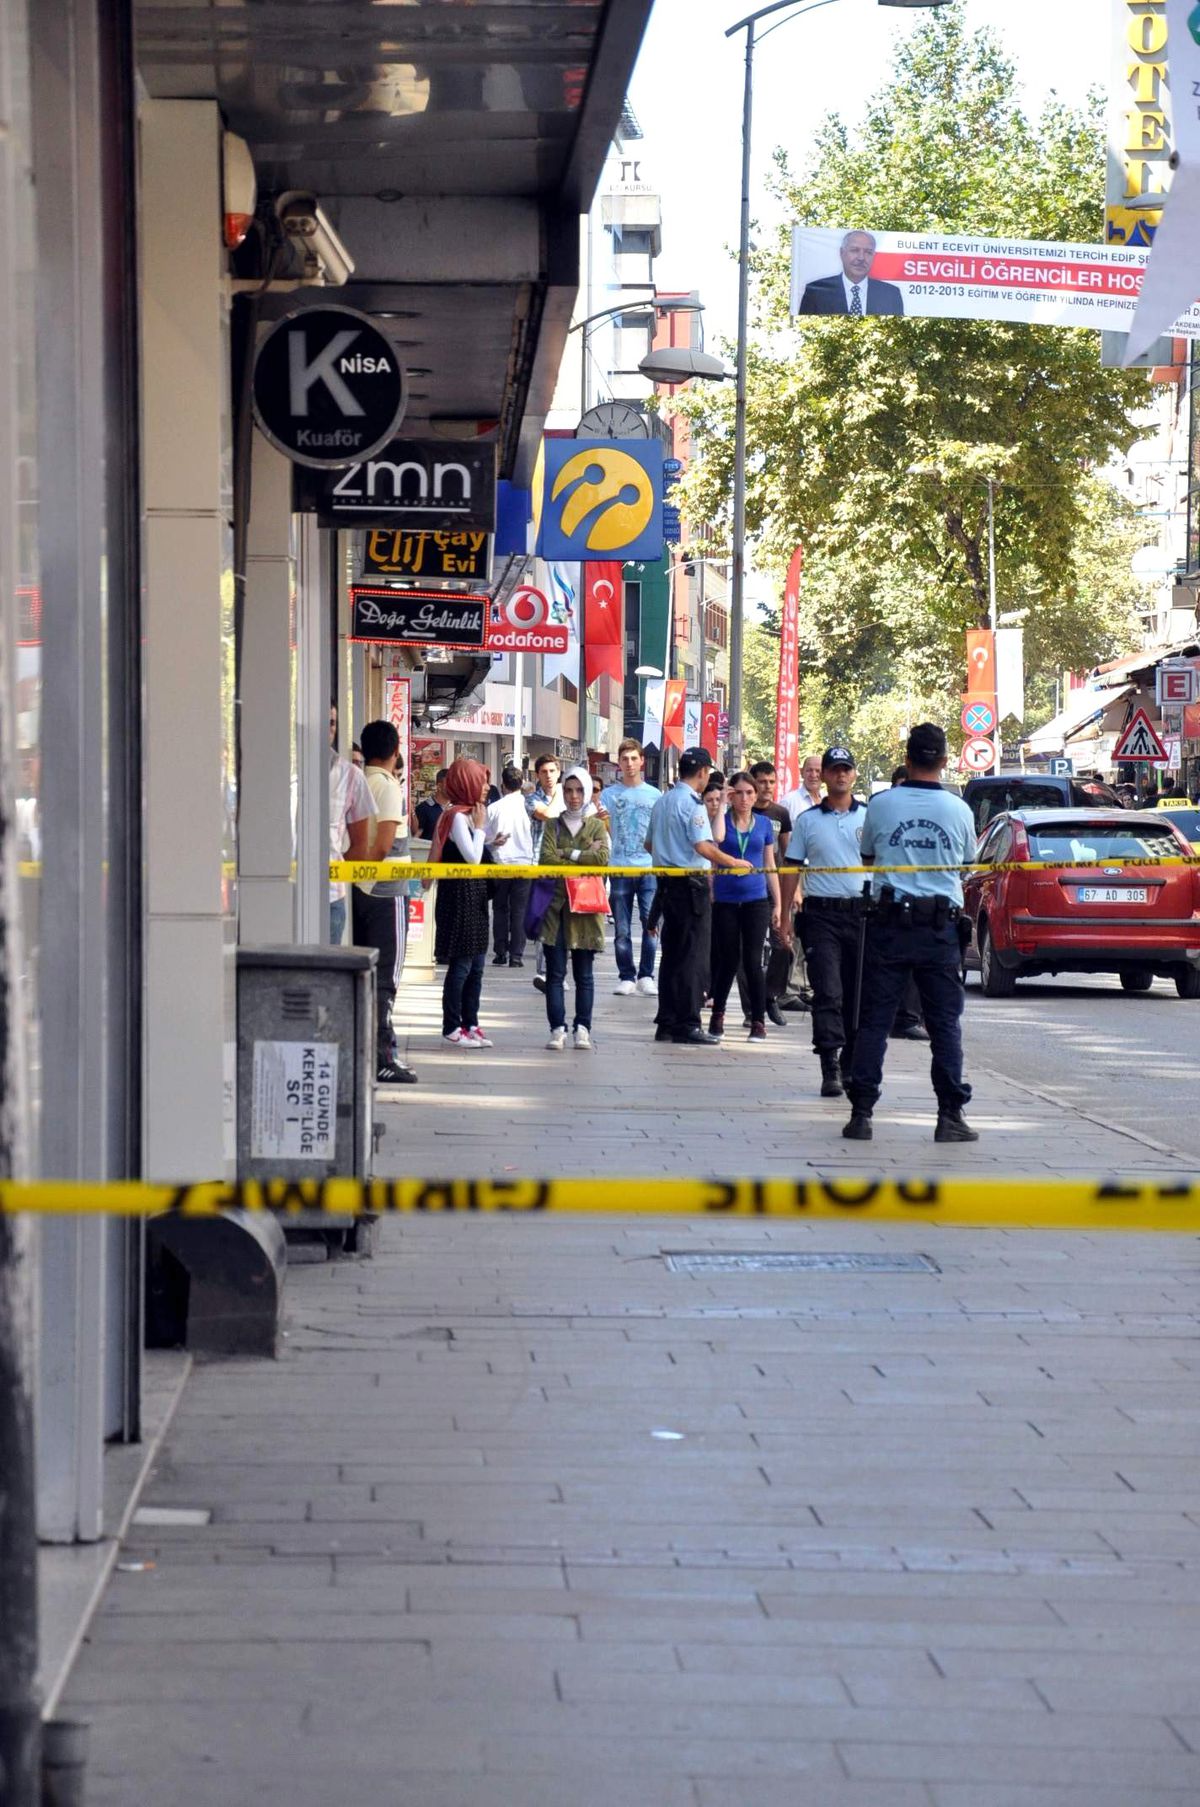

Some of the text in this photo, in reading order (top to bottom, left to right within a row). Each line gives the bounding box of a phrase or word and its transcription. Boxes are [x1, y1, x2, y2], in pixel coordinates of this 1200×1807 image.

[1122, 0, 1169, 199] OTEL
[942, 242, 979, 252] ECEVİT
[904, 259, 975, 279] SEVGİLİ
[980, 261, 1103, 288] ÖĞRENCİLER
[909, 284, 965, 297] 2012-2013
[1001, 291, 1013, 300] VE
[288, 330, 366, 416] K
[340, 353, 391, 373] NİSA
[296, 429, 362, 447] Kuaför
[442, 553, 476, 573] Evi
[358, 600, 481, 631] Doğa Gelinlik
[1167, 675, 1186, 698] E
[1055, 760, 1068, 777] P
[1084, 889, 1096, 901] 67
[1127, 890, 1145, 901] 305
[318, 1061, 331, 1080] 14
